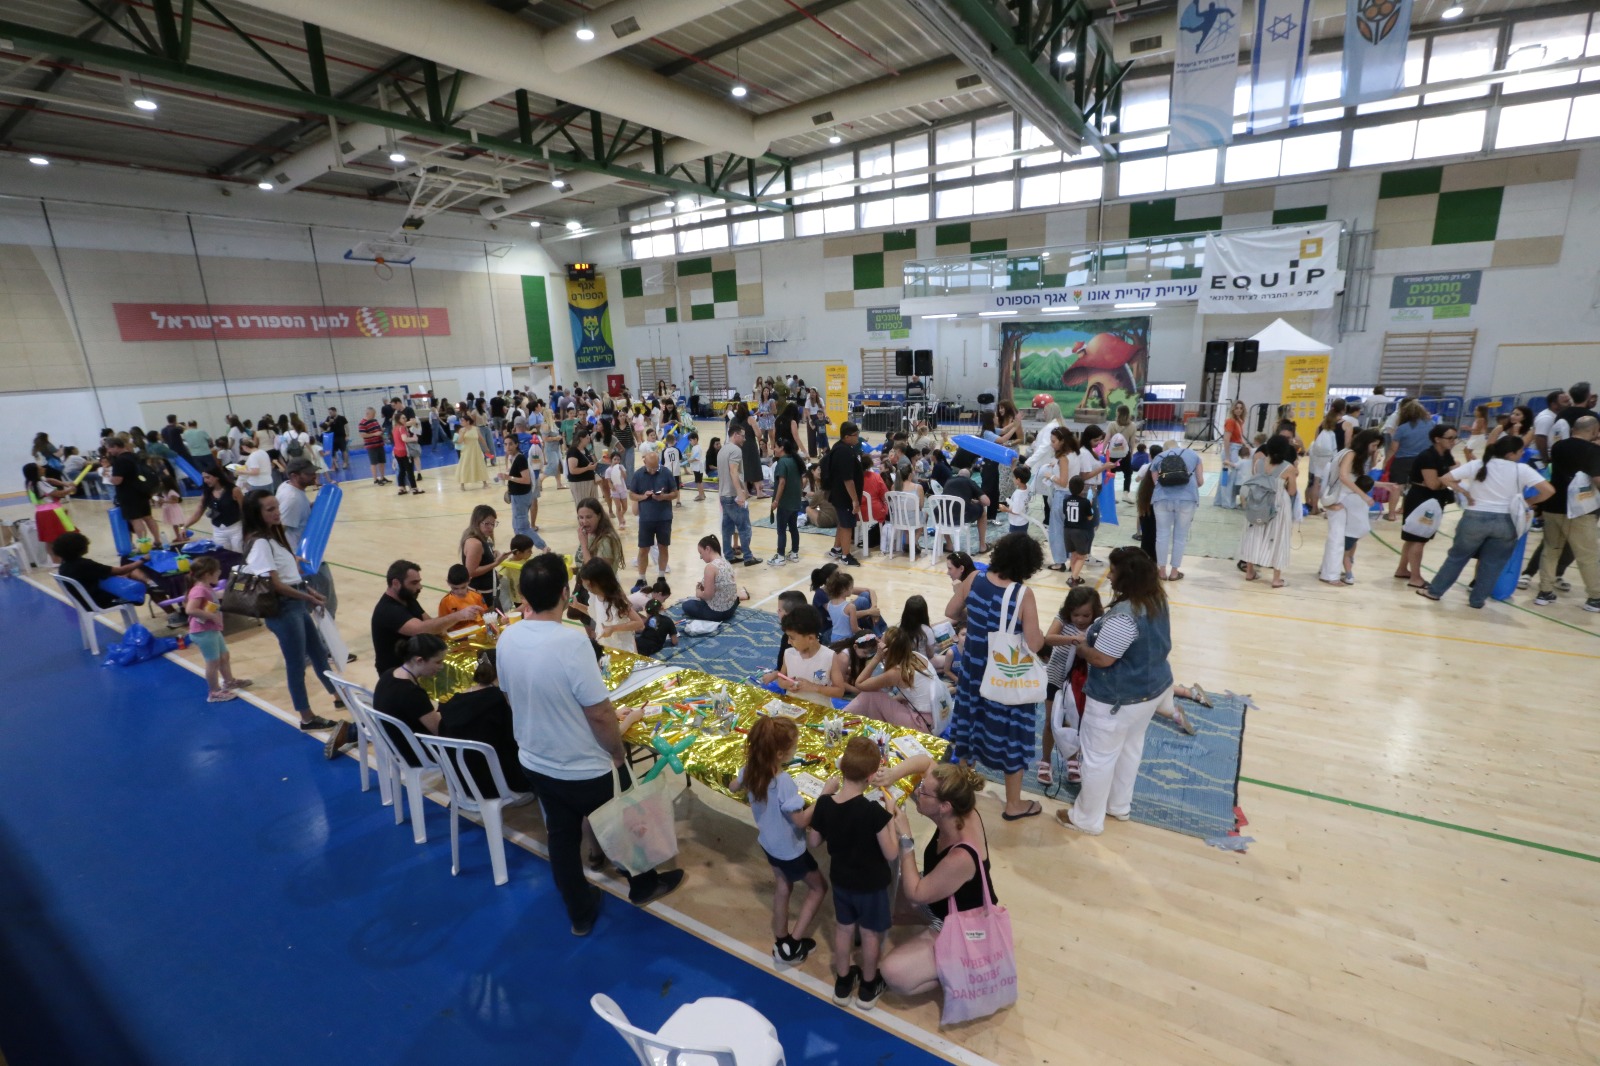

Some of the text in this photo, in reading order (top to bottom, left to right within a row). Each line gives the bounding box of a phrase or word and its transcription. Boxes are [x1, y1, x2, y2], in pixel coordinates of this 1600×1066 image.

[571, 292, 604, 301] הספורט
[996, 284, 1198, 306] עיריית קריית אונו אגף הספורט
[1406, 293, 1460, 305] לספורט
[150, 311, 430, 331] טוטו למען הספורט בישראל
[582, 345, 606, 354] עיריית
[592, 354, 613, 364] קריית
[1067, 506, 1079, 522] 10
[990, 676, 1040, 689] tortillas
[960, 951, 1003, 970] WHEN IN
[953, 987, 988, 1000] DANCE
